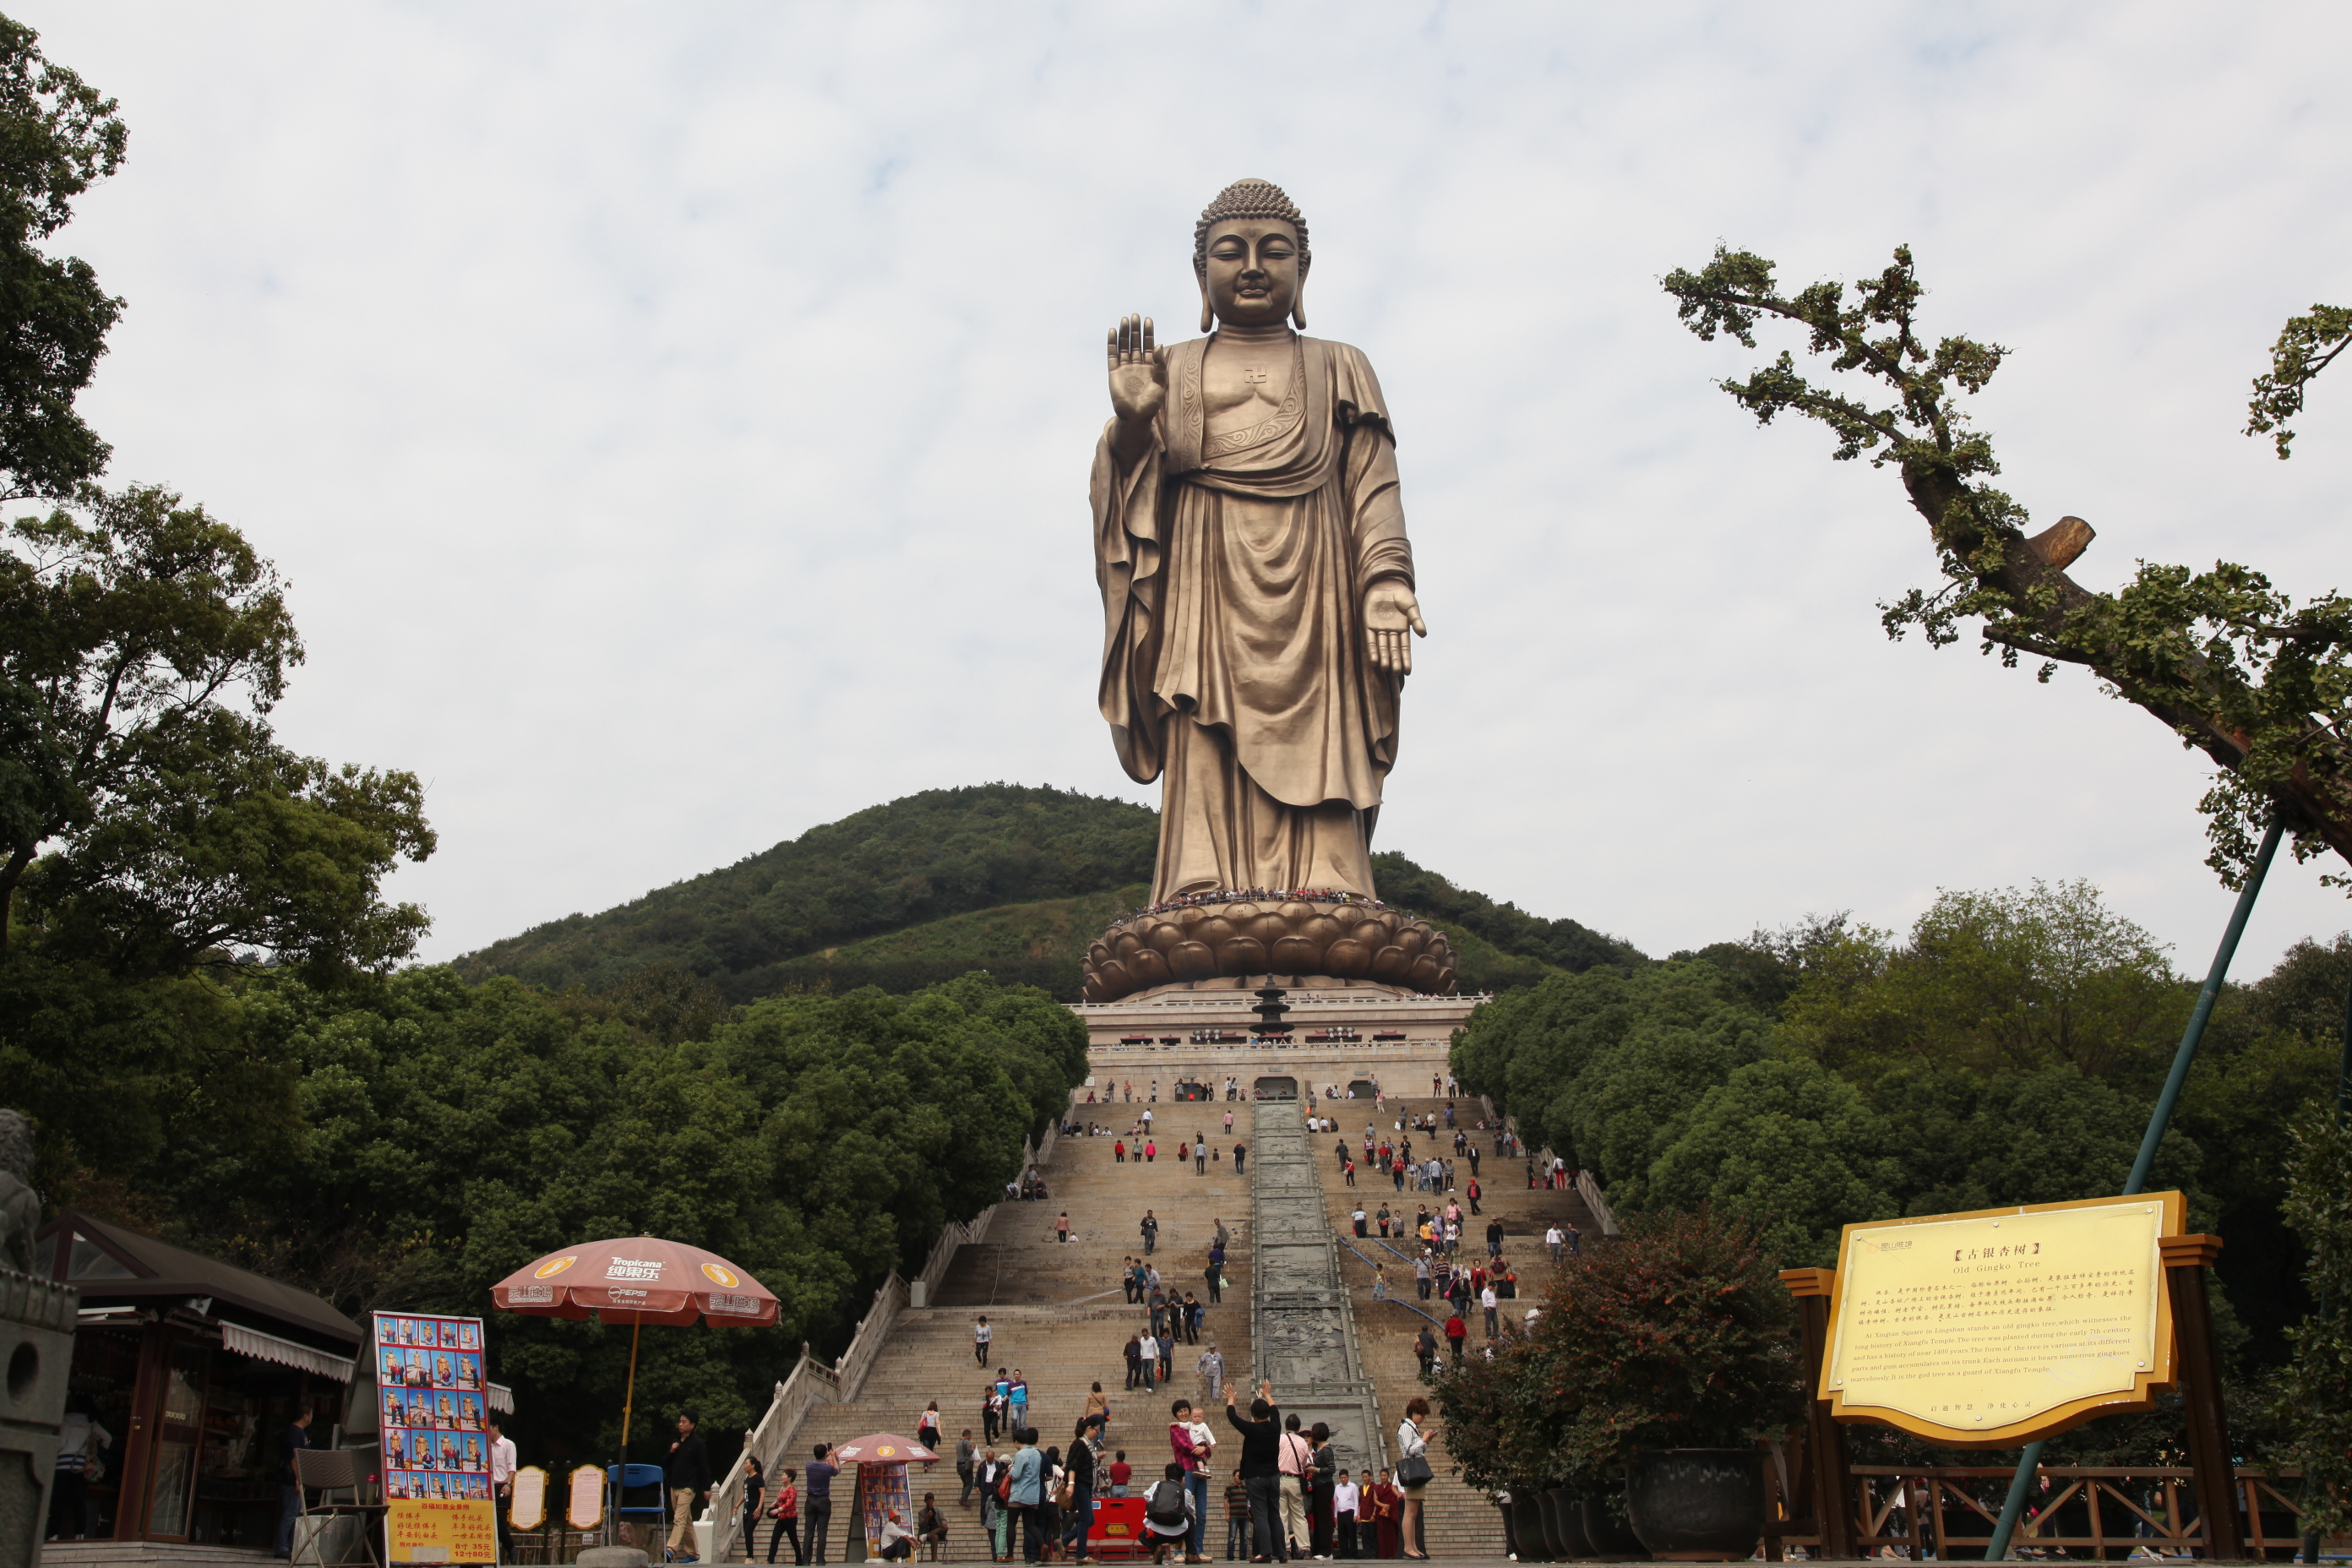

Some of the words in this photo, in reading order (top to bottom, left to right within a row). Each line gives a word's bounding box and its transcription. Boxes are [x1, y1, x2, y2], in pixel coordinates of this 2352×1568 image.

[611, 1256, 662, 1268] Tropicana
[607, 1266, 661, 1279] 纯果乐
[1976, 1264, 2011, 1272] Gingko
[619, 1288, 648, 1298] PEPSI
[2042, 1319, 2079, 1327] tree,which
[2103, 1327, 2132, 1336] century
